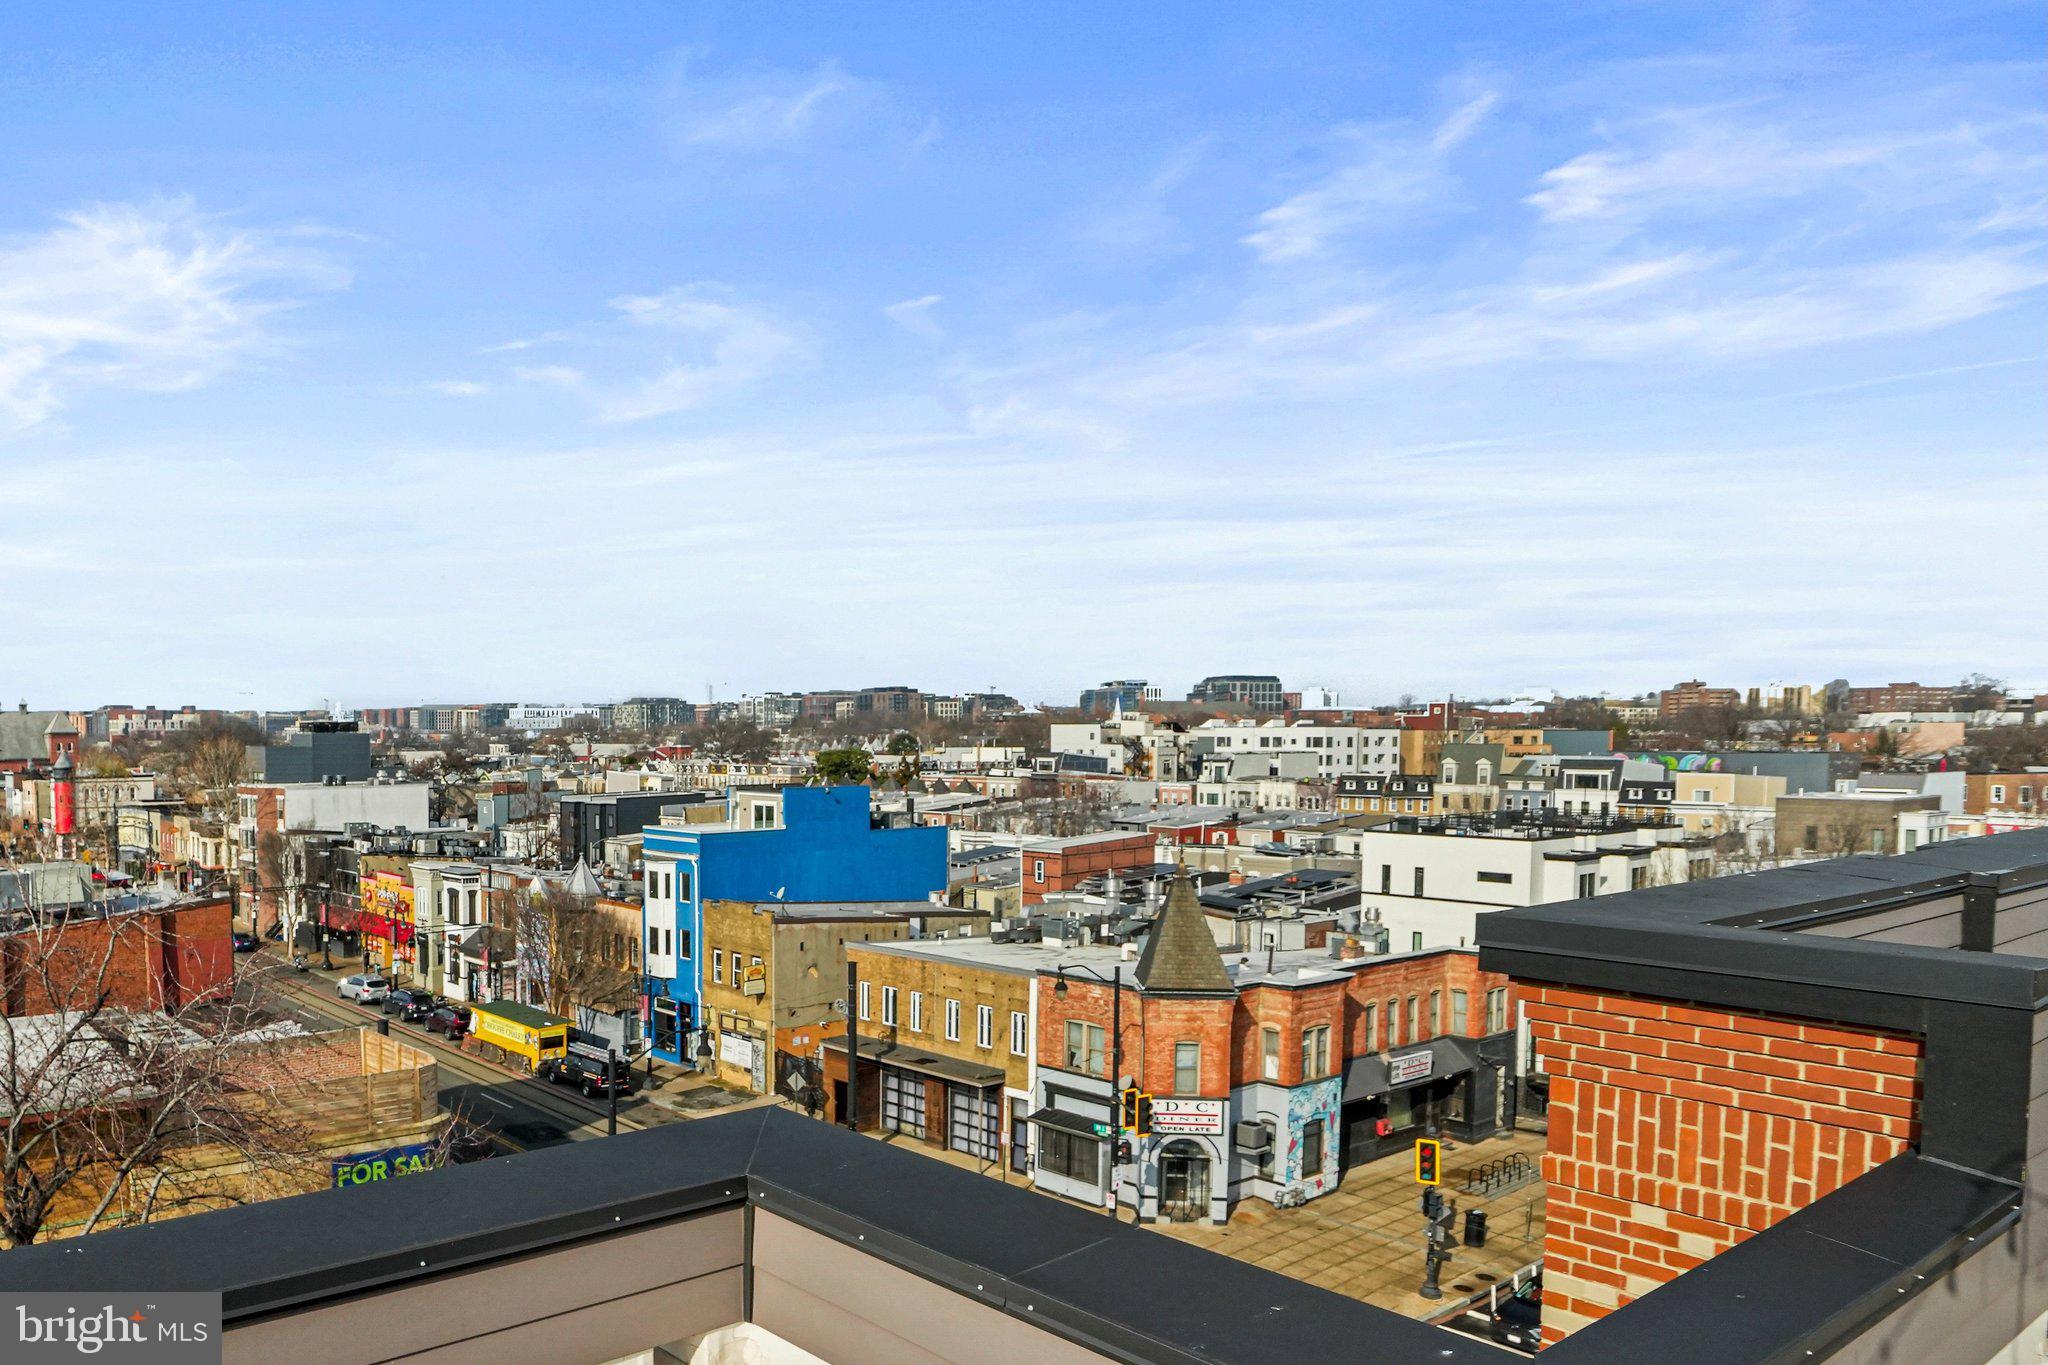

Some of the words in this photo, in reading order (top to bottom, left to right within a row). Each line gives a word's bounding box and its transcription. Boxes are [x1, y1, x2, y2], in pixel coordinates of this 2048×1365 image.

[1165, 1101, 1179, 1112] D
[1196, 1102, 1209, 1113] C
[337, 1161, 387, 1187] FOR
